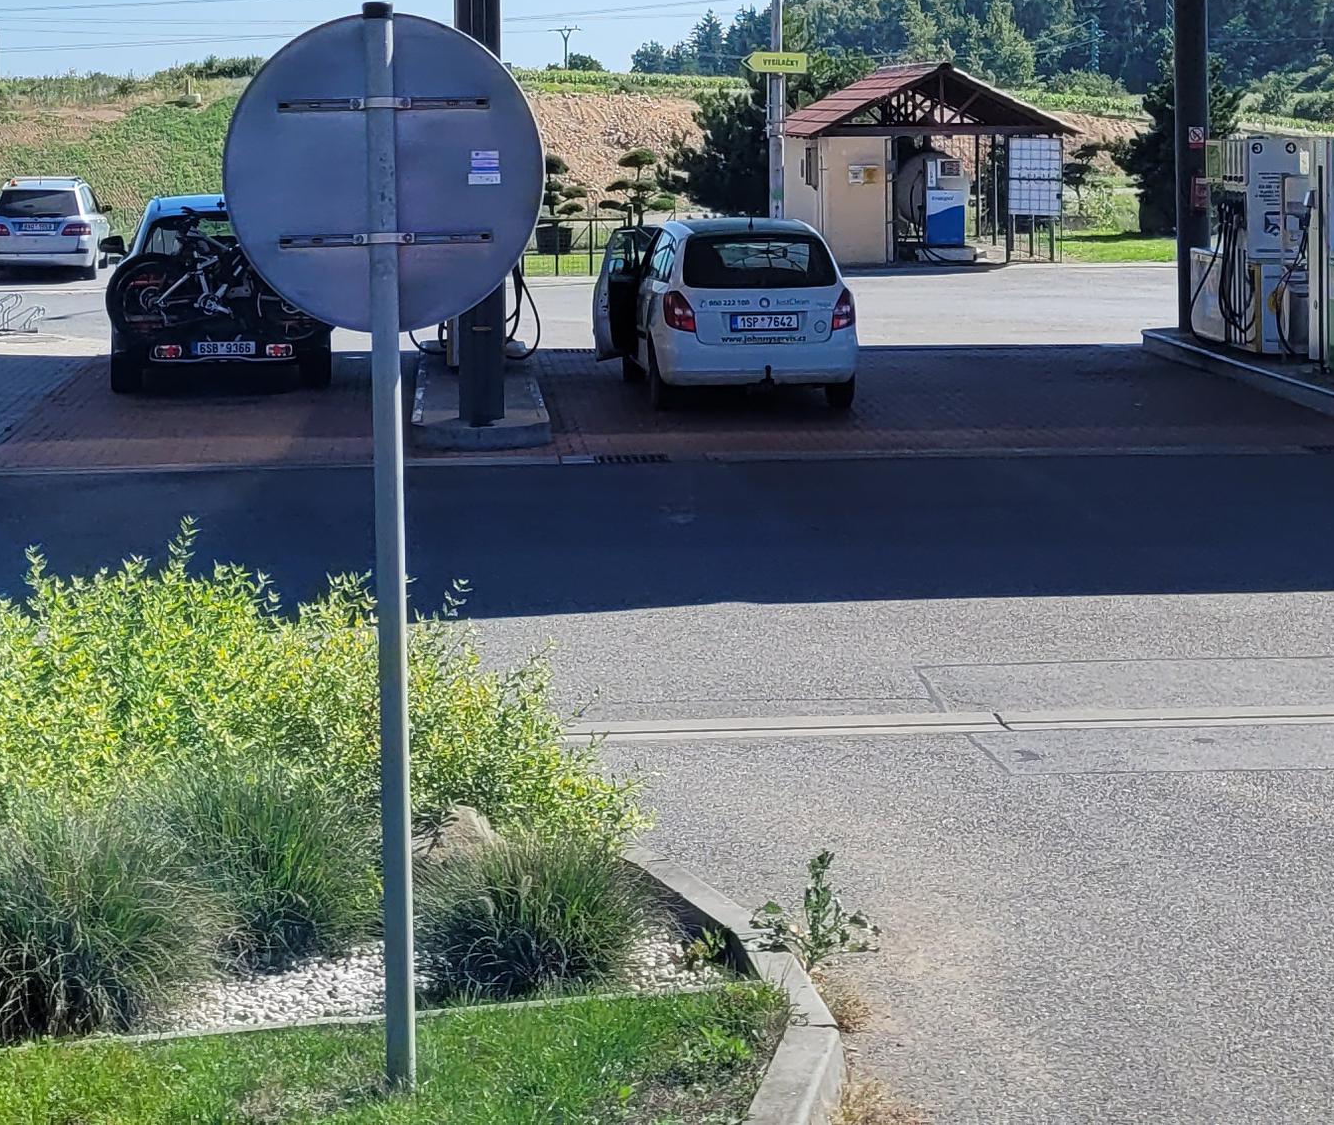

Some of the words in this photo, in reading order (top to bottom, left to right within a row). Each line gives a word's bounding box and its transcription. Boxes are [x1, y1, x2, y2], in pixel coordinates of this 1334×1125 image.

[740, 316, 759, 328] 1SP
[766, 316, 793, 328] 7642
[199, 343, 219, 354] 6SB
